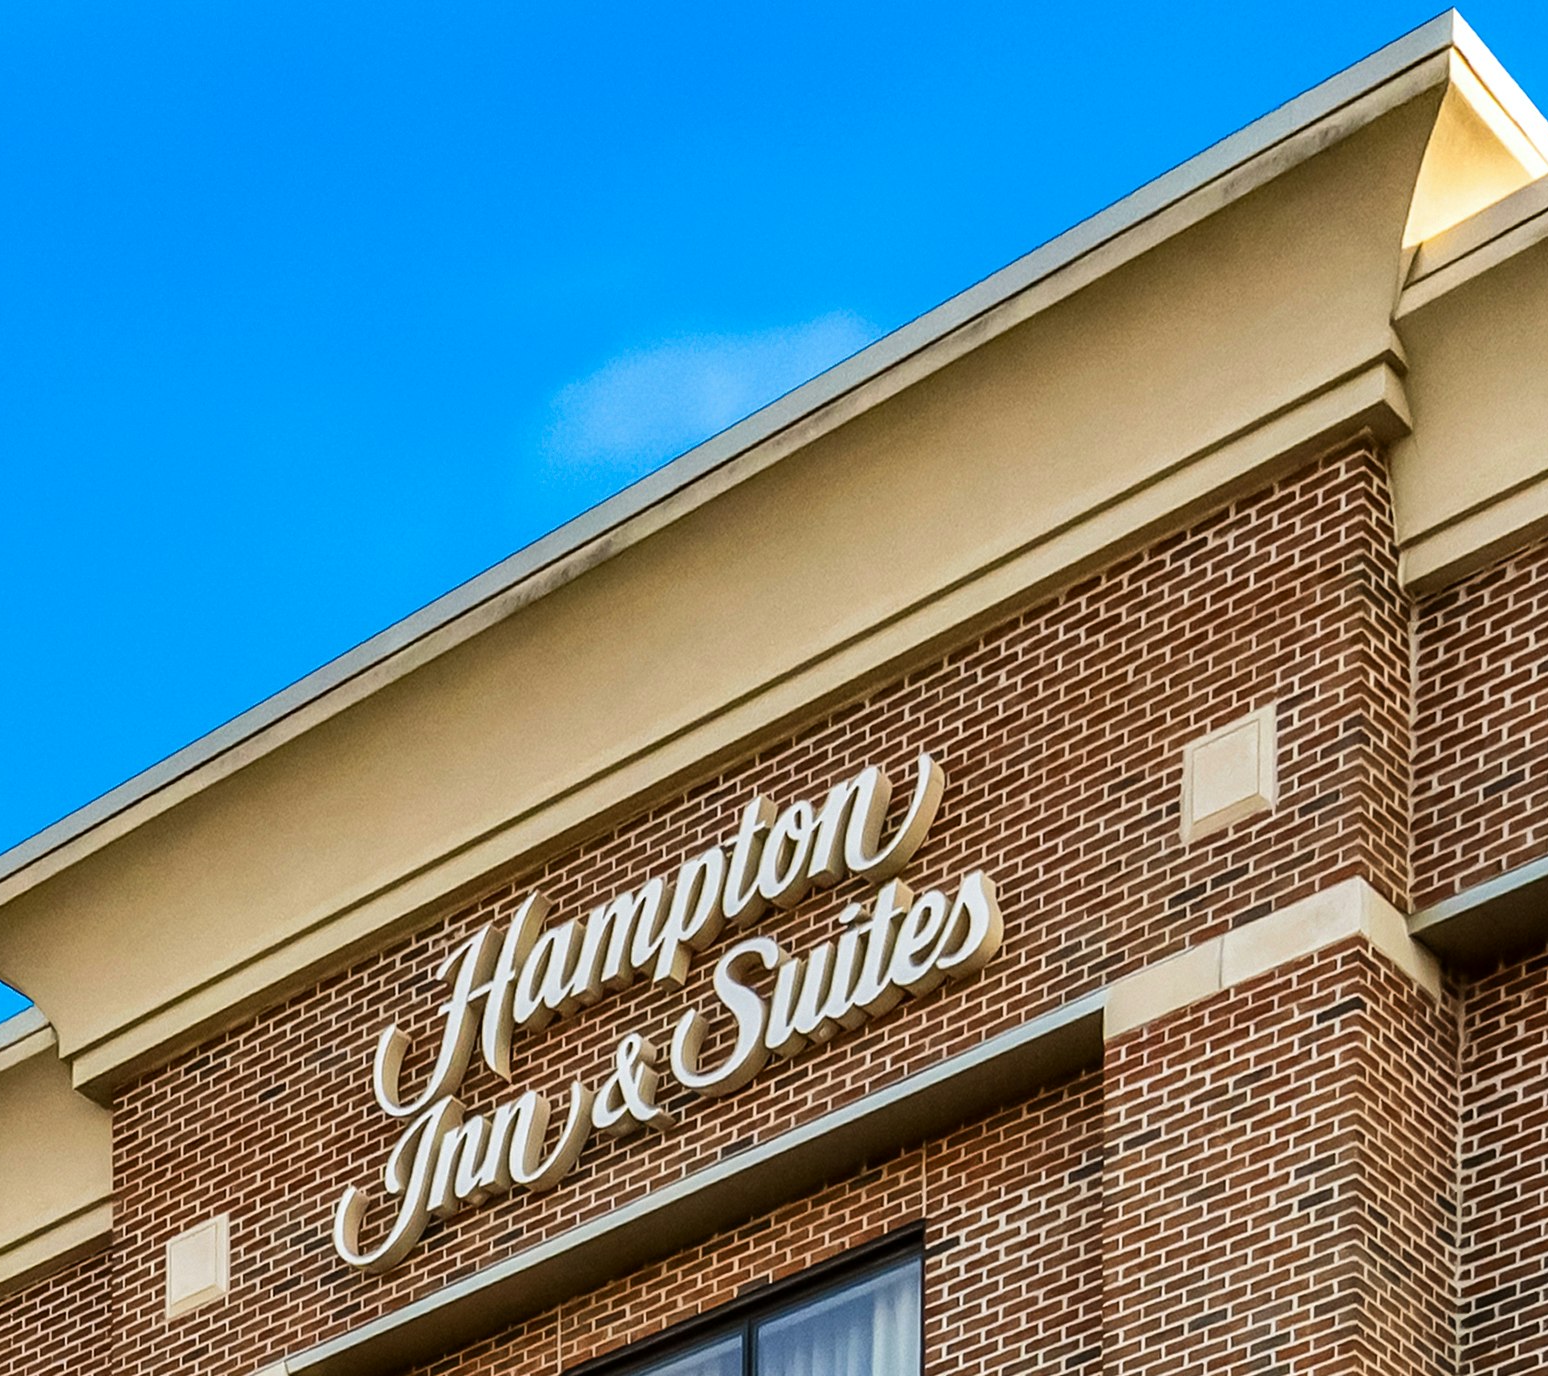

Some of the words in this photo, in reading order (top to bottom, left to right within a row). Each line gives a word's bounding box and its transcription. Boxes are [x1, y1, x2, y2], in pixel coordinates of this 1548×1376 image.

[334, 1080, 592, 1274] Inn
[592, 1032, 676, 1137] &
[671, 870, 1003, 1098] Suites
[373, 752, 945, 1120] Hampton
